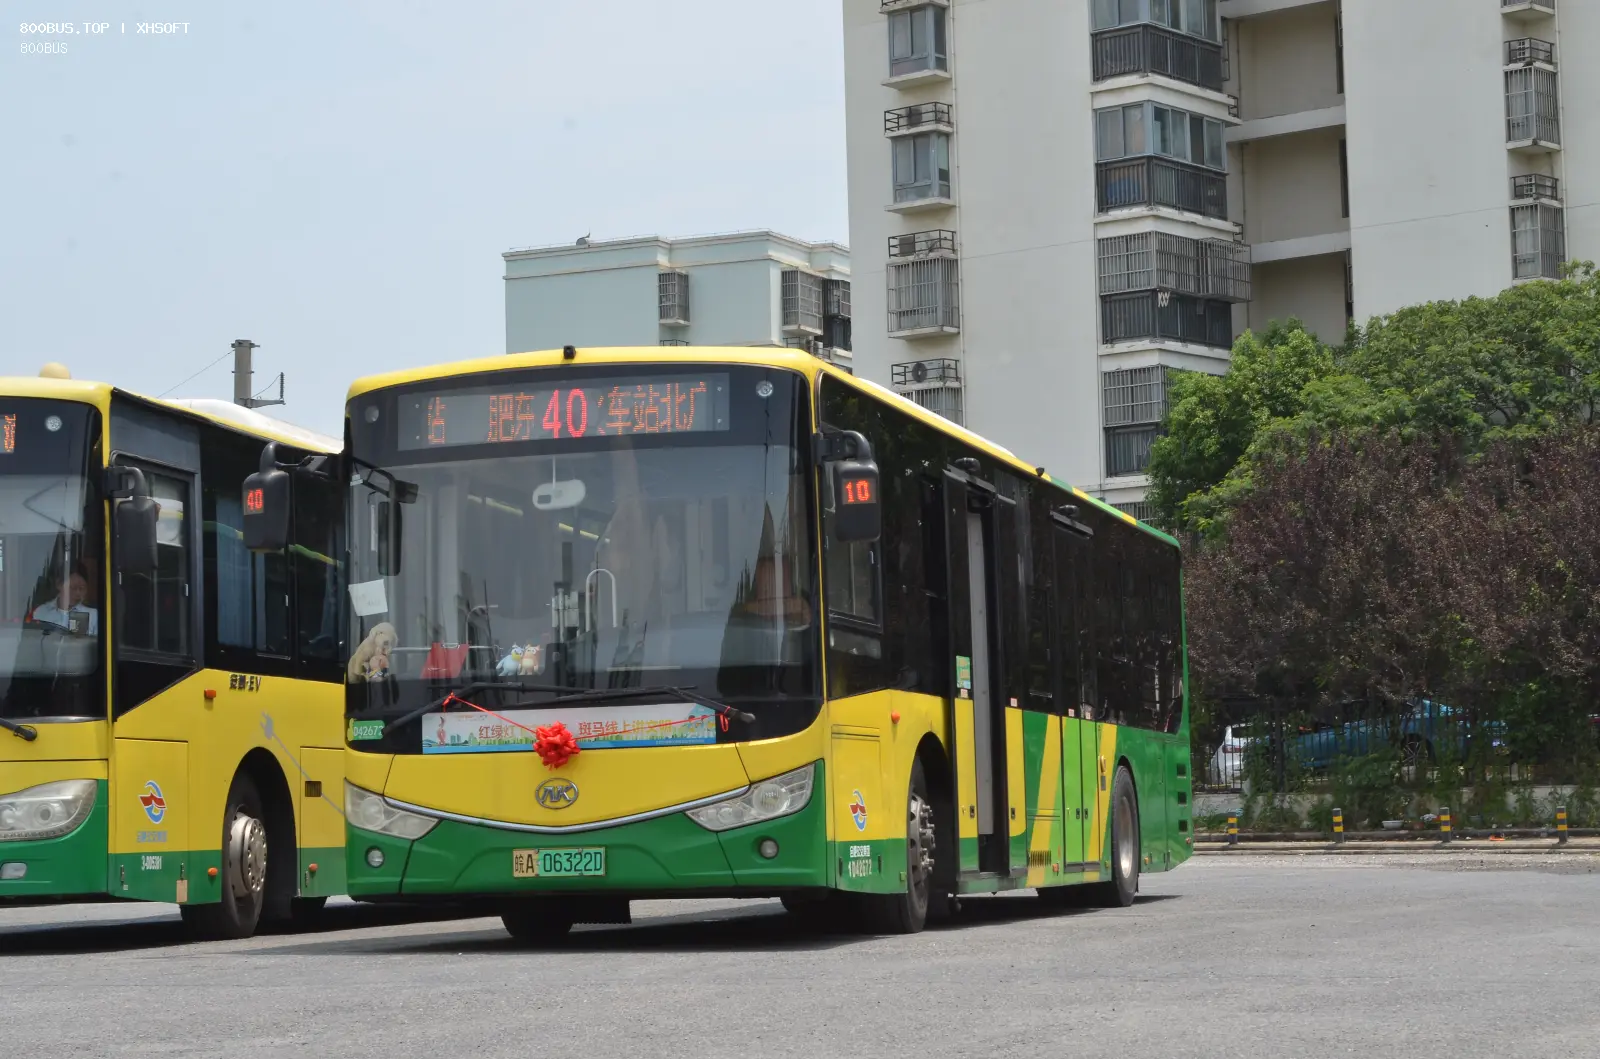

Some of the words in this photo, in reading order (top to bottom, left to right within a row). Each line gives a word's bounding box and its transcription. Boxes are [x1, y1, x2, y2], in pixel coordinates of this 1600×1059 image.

[542, 388, 587, 438] 40
[598, 381, 706, 436] 车站北广
[515, 854, 535, 874] 皖A
[543, 852, 602, 873] 06322D
